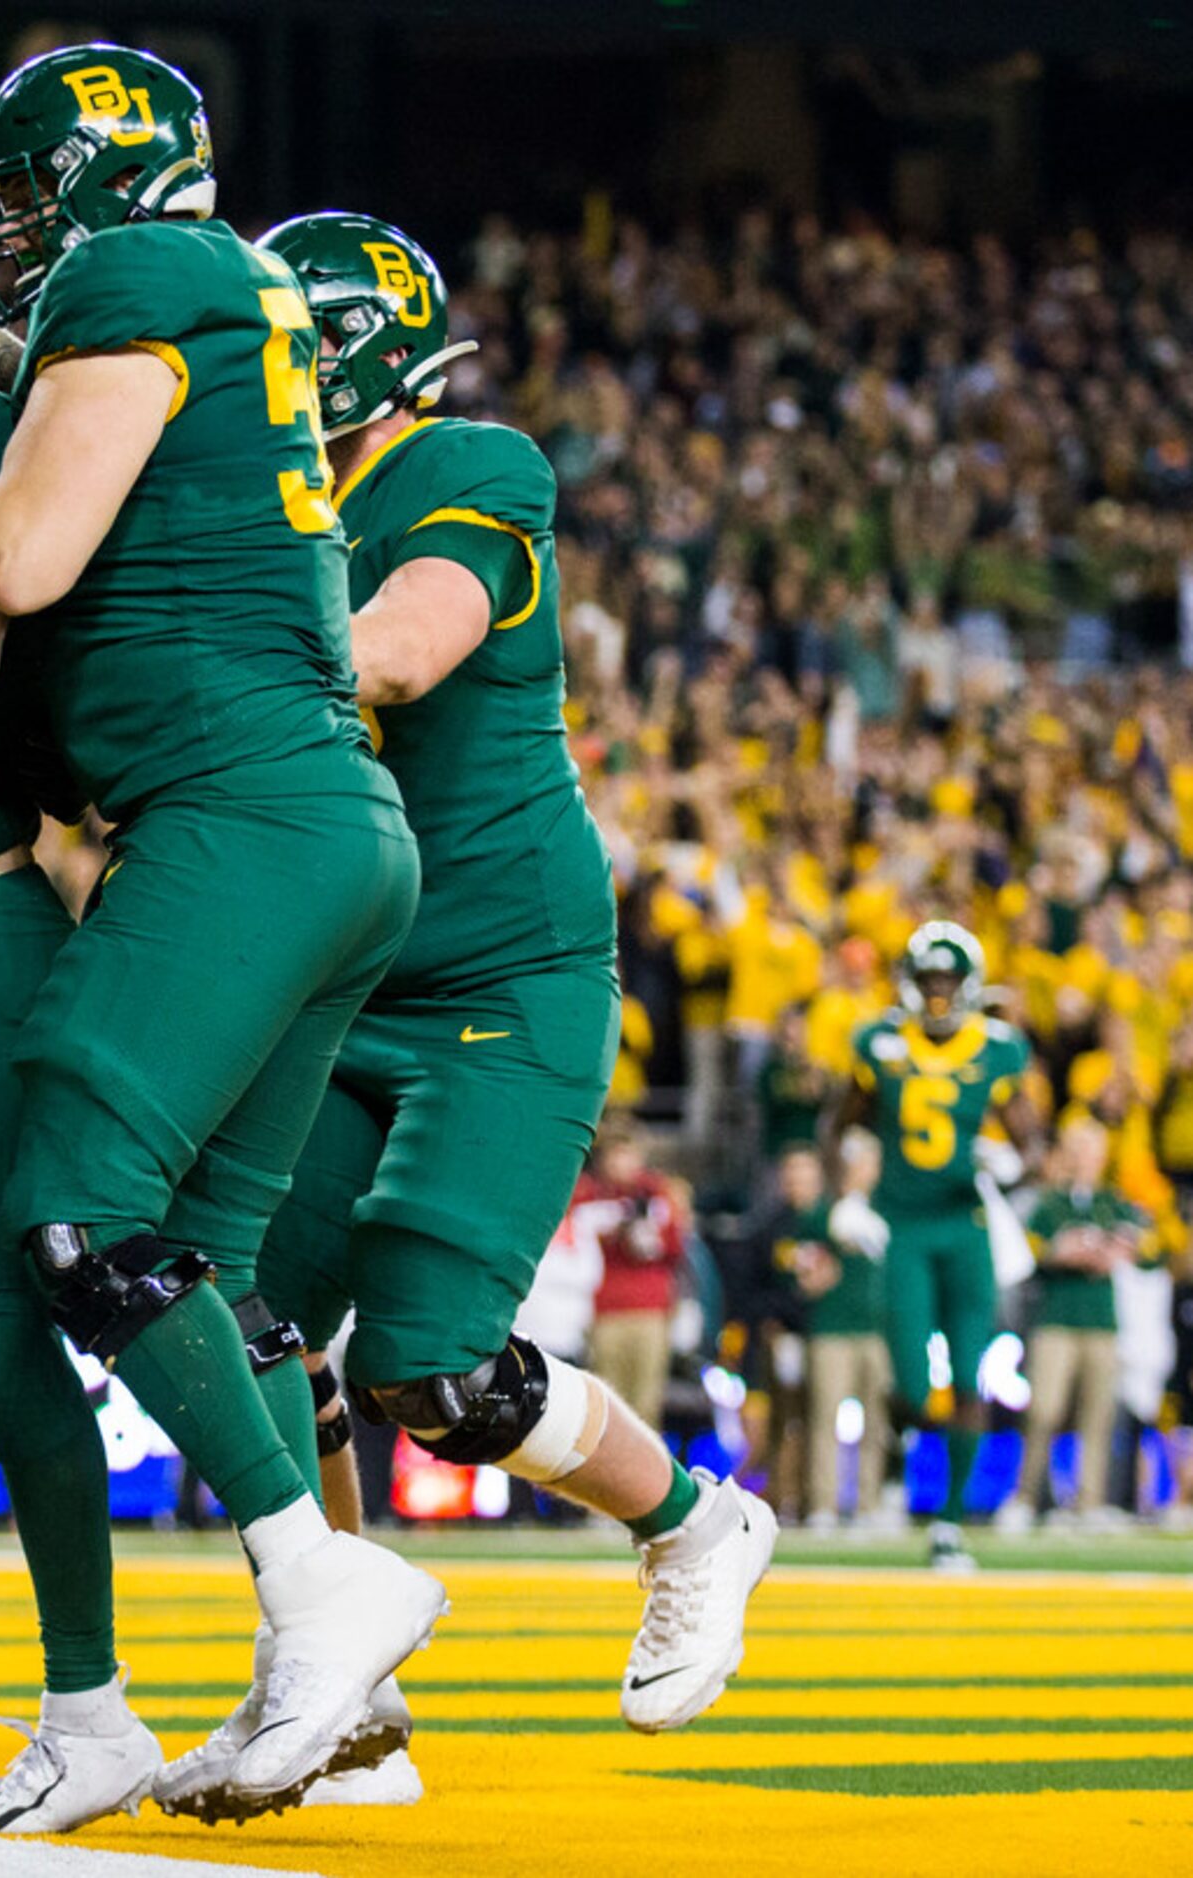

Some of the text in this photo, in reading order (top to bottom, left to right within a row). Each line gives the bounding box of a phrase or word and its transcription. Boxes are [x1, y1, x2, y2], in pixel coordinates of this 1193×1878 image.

[62, 65, 156, 147] BU
[360, 243, 432, 328] BU
[898, 1075, 960, 1170] 5
